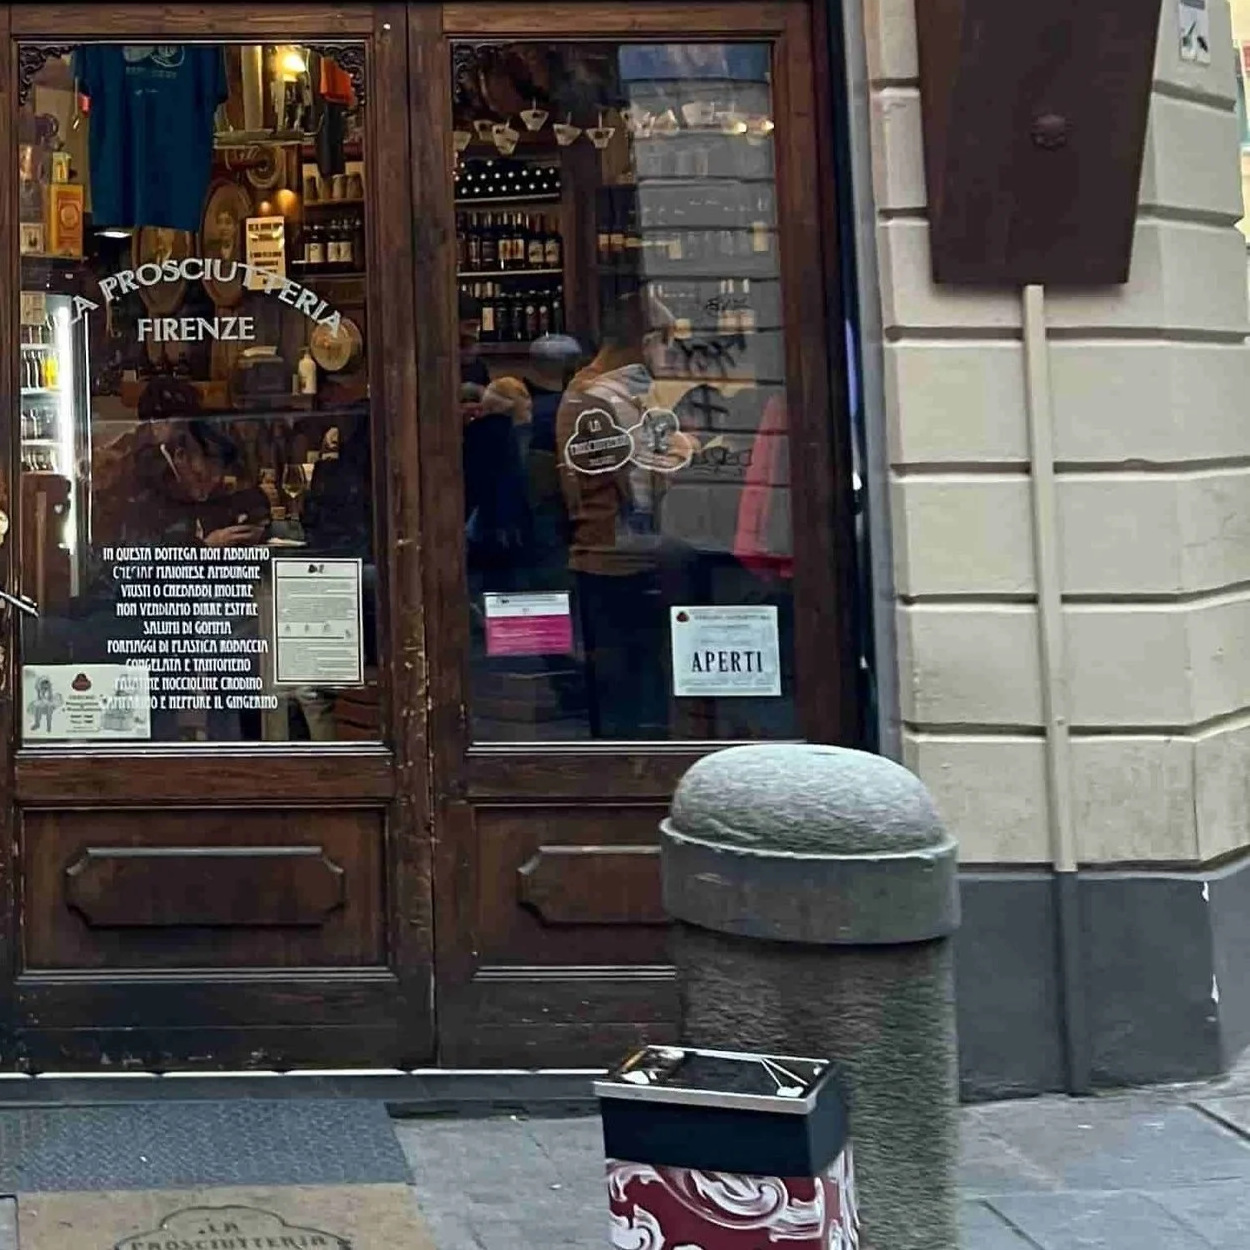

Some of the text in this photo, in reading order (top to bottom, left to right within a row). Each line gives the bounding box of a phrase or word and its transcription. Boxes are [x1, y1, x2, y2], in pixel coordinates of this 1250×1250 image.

[98, 258, 342, 339] PROSCIUTTERIA
[137, 317, 256, 342] FIRENZE
[103, 547, 270, 561] IN QUESTA BOTTEGA NON ABBIAMO
[156, 565, 205, 579] MAIONESE
[153, 584, 161, 598] O
[116, 603, 137, 616] NON
[139, 603, 191, 616] VENDIAMO
[143, 621, 232, 635] SALUMI DI GOMMA
[107, 639, 269, 653] FORMAGGI DI PLASTICA ROBACCIA
[184, 658, 191, 672] E
[691, 650, 763, 673] APERTI
[162, 676, 219, 690] NOCCIOLINE
[220, 676, 263, 690] CRODINO
[168, 695, 212, 710] NEPPURE
[225, 695, 278, 710] GINGERINO
